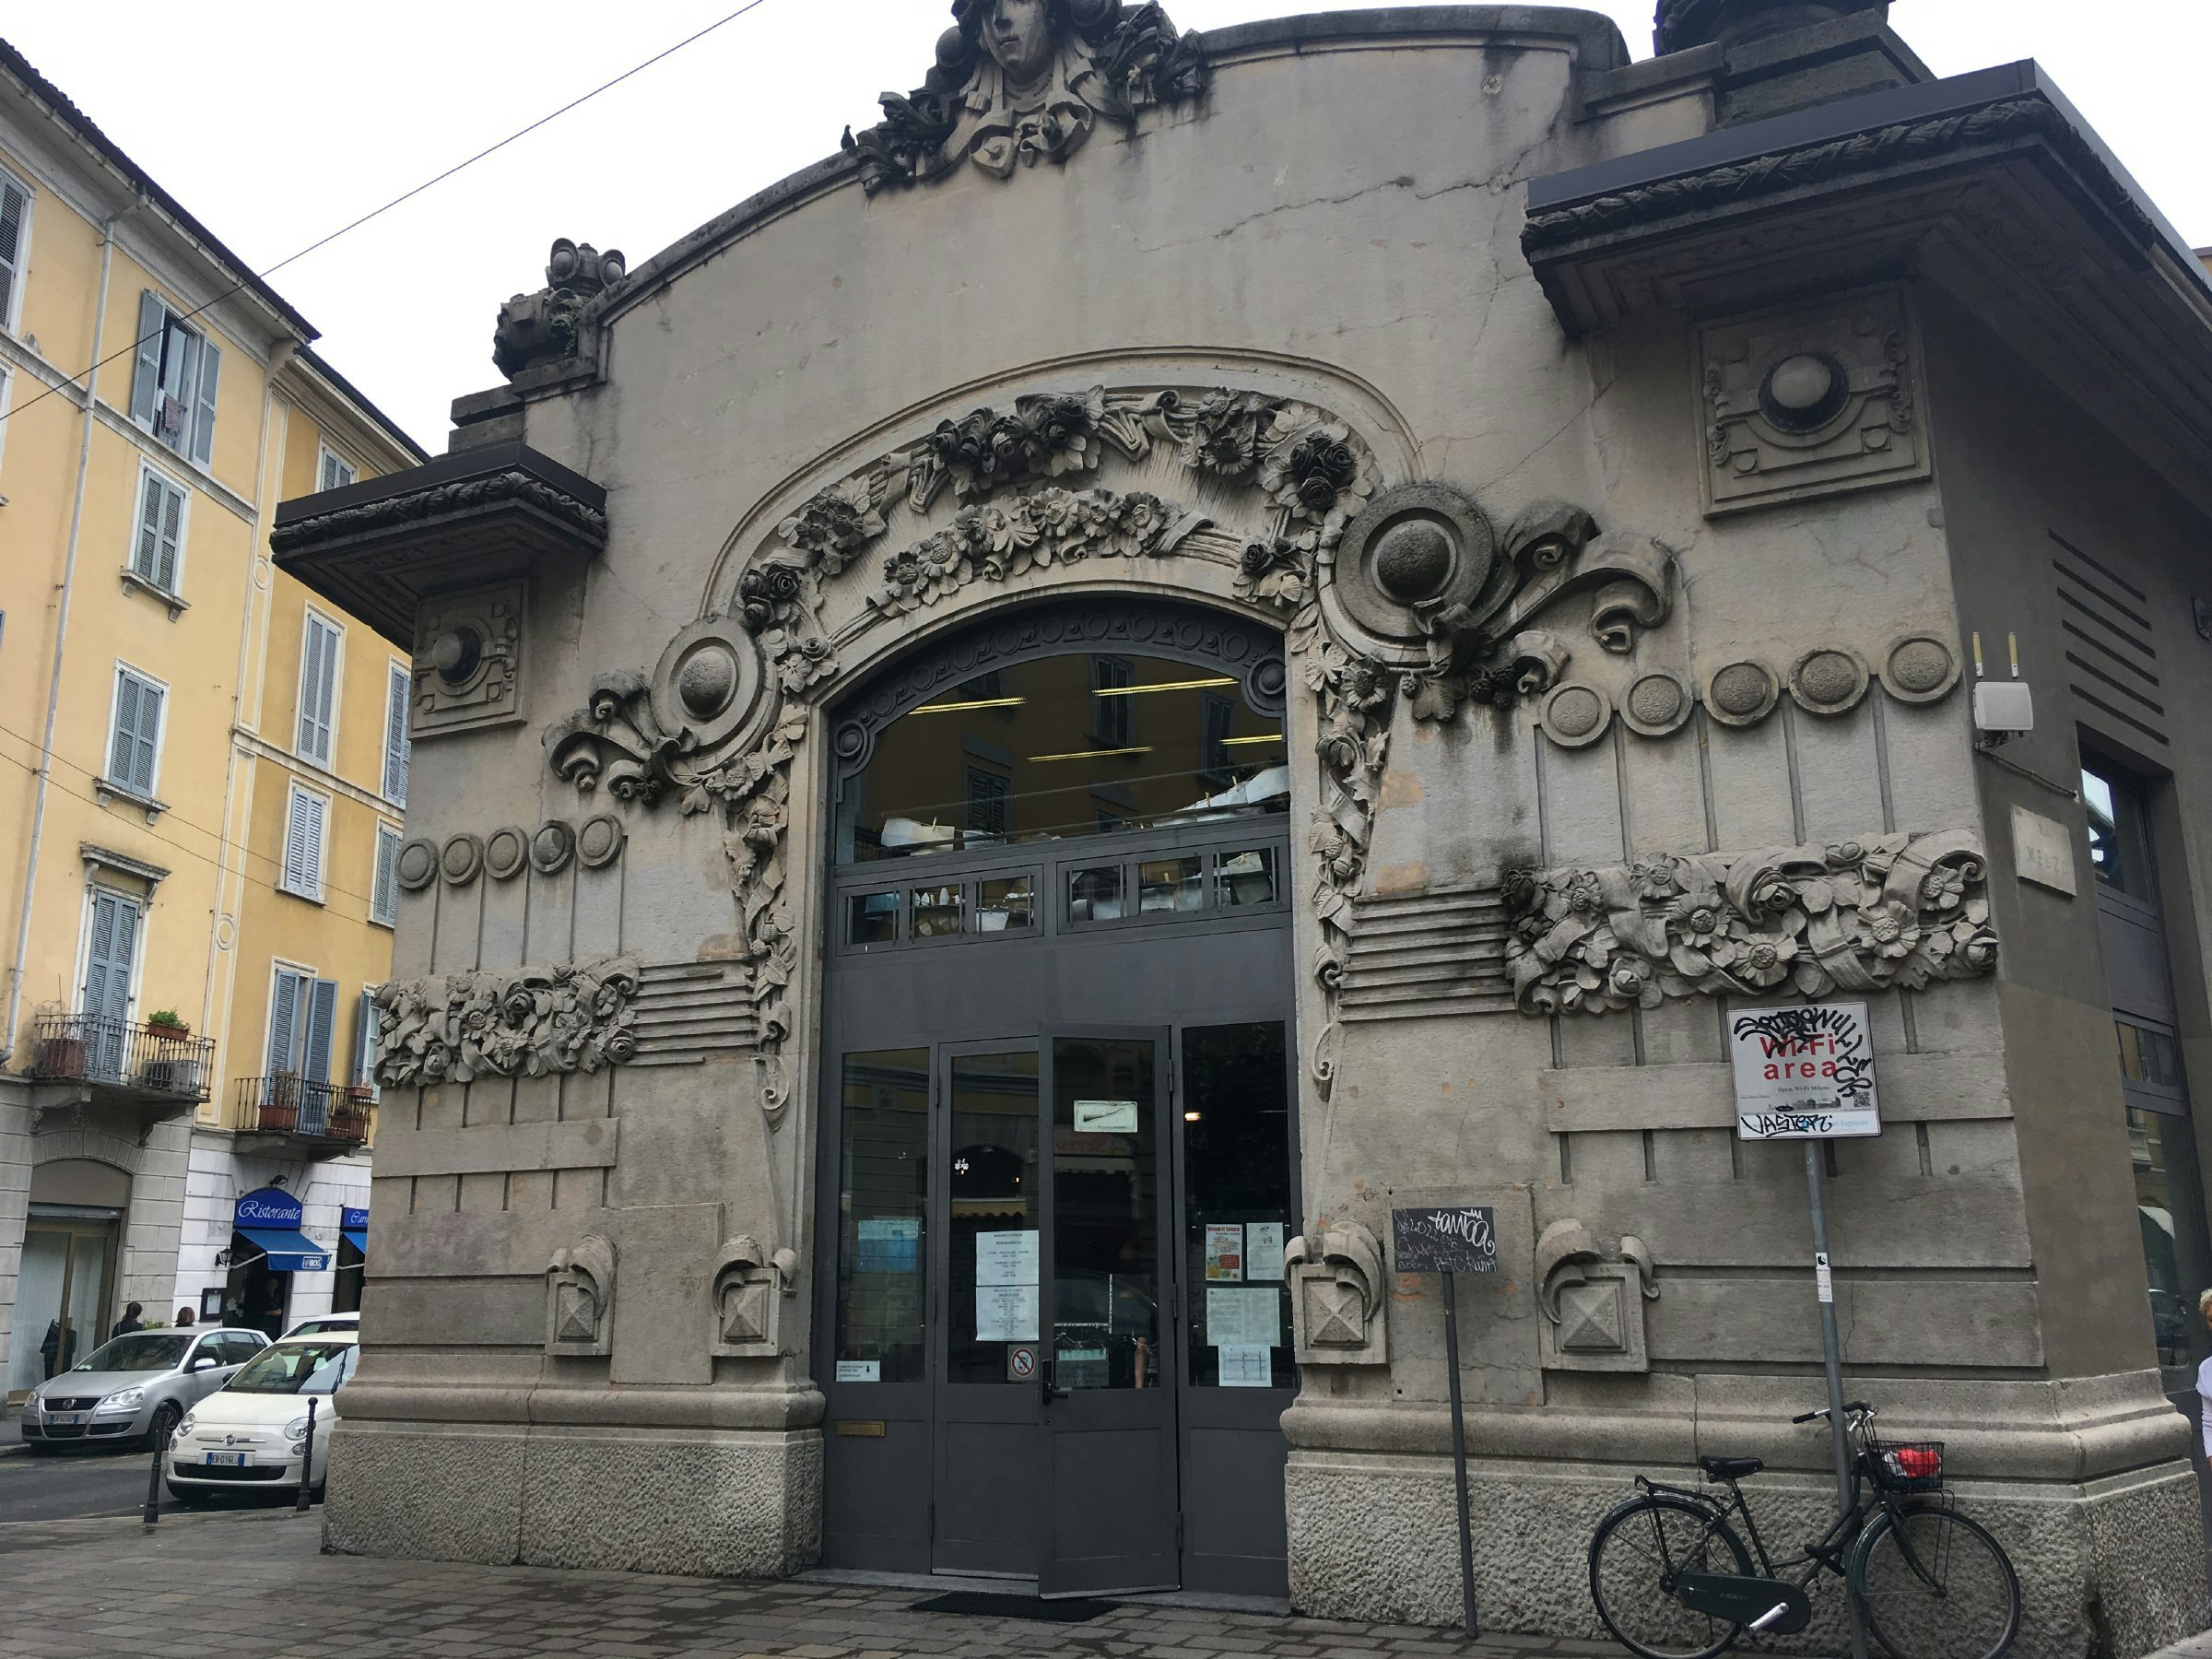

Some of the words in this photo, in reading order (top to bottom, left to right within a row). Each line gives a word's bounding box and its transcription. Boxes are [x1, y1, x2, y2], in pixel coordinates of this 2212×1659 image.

[2027, 845, 2068, 876] MELZO
[1759, 1033, 1836, 1057] Wi-Fi
[1763, 1060, 1837, 1080] area
[1841, 1120, 1869, 1129] Explorer
[238, 1200, 301, 1220] Ristorante
